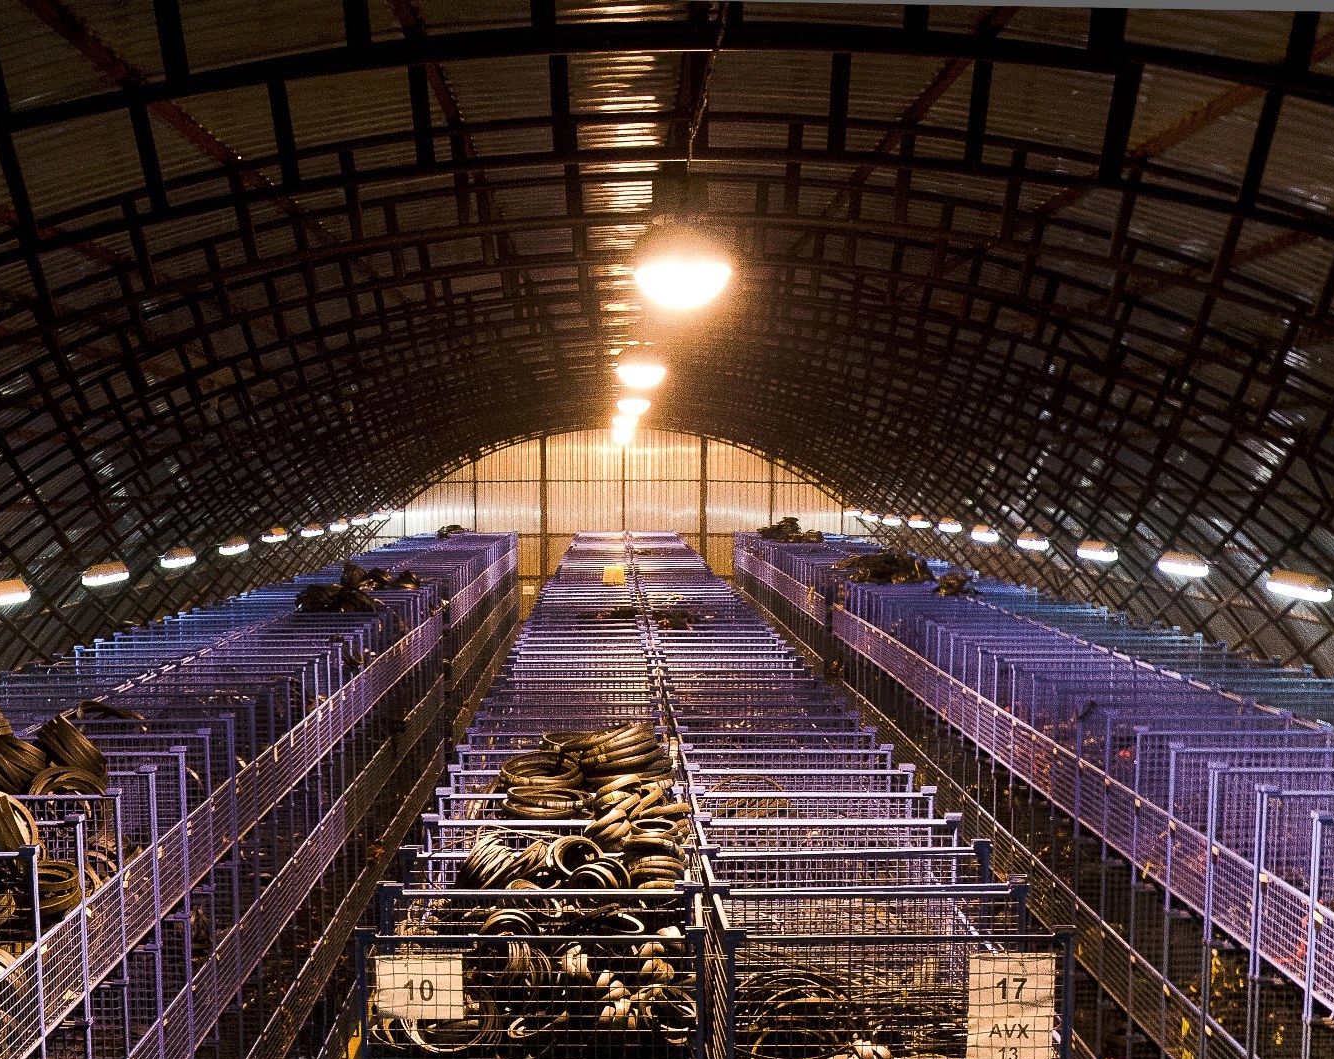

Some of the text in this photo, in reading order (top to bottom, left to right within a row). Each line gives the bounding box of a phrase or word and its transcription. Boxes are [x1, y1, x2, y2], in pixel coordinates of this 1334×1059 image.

[403, 980, 434, 1001] 10
[995, 978, 1027, 999] 17
[990, 1024, 1029, 1039] AVX
